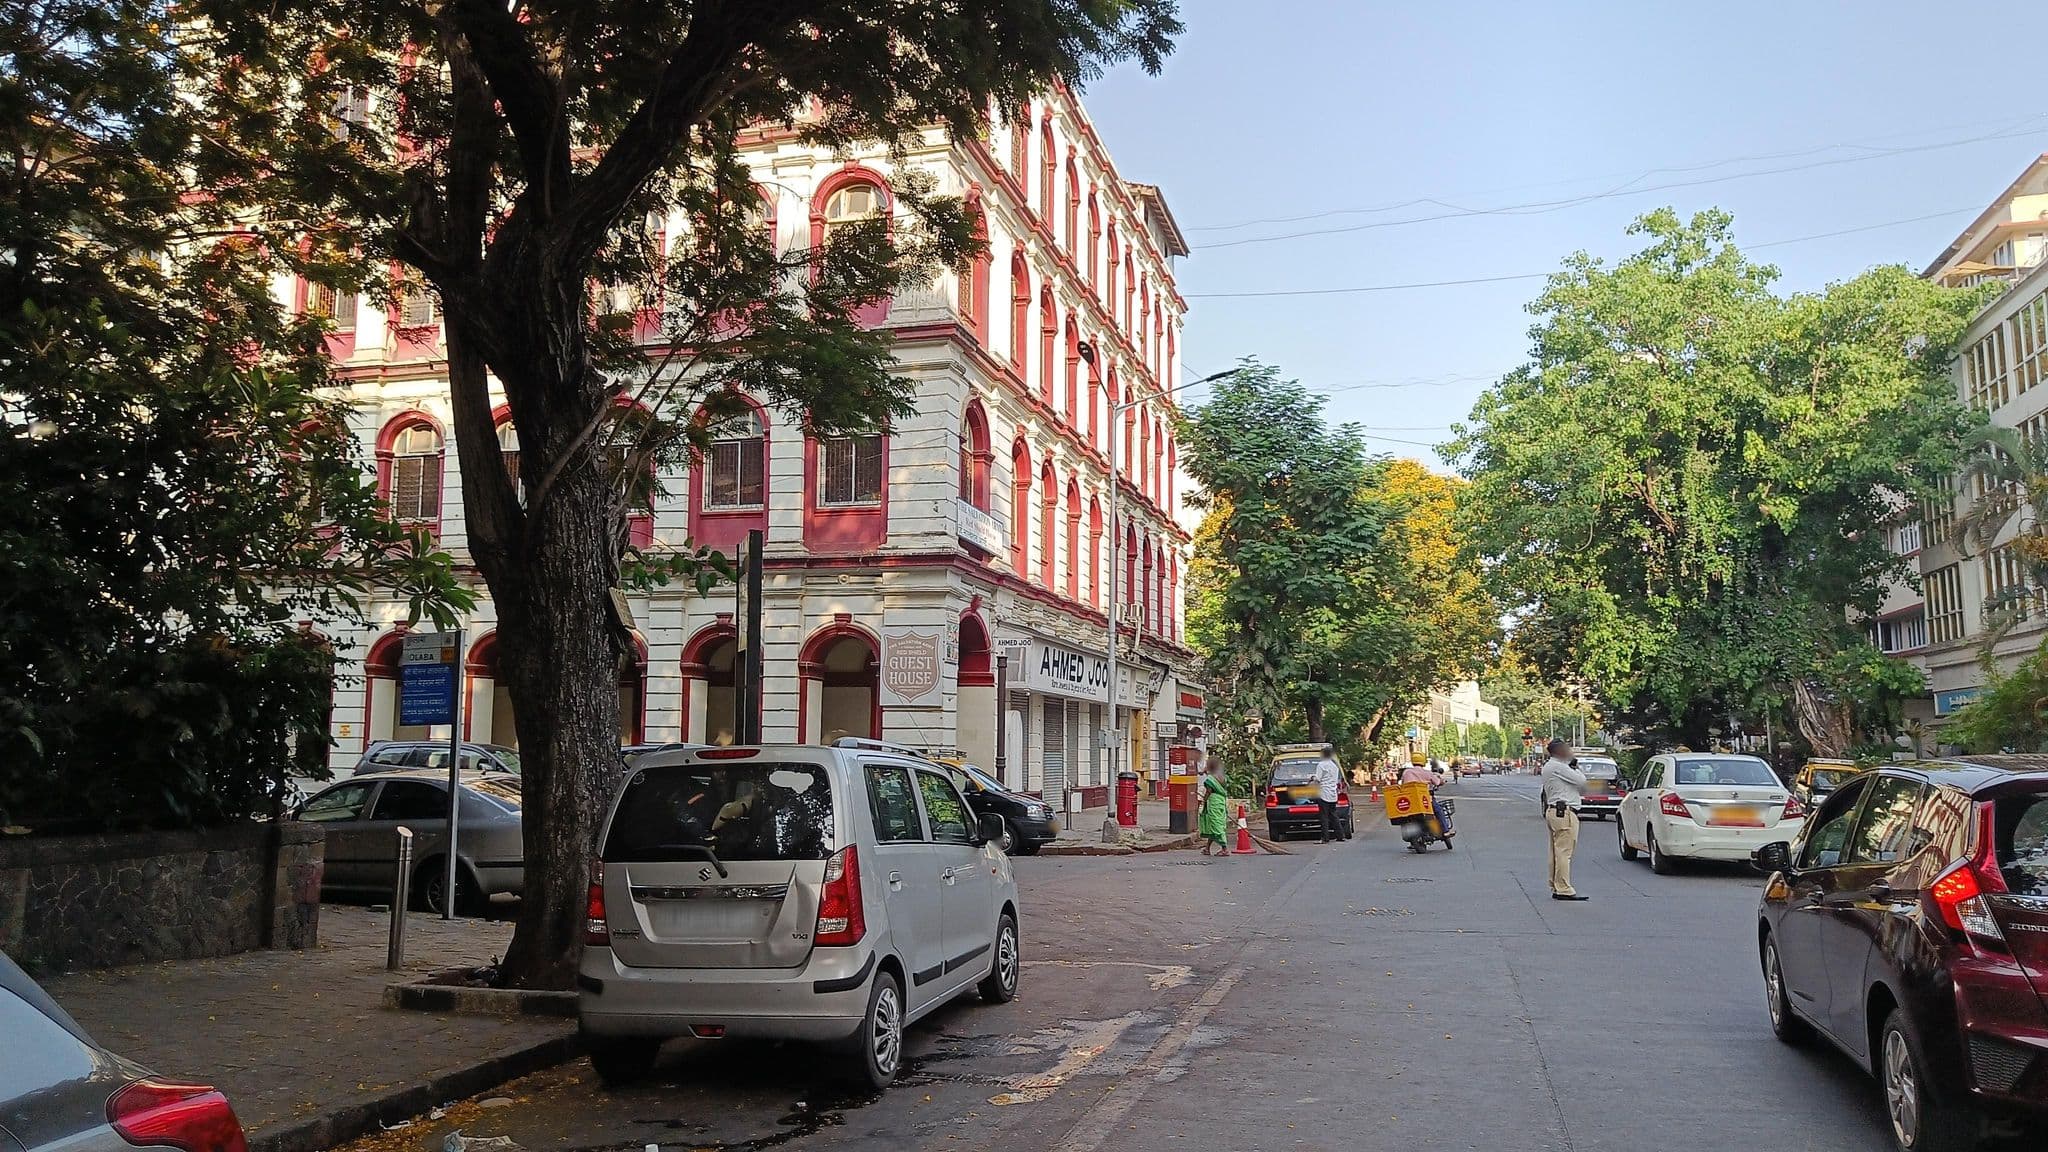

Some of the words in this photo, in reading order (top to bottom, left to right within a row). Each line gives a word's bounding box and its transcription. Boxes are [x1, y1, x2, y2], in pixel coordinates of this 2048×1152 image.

[889, 656, 933, 670] GUEST
[1040, 646, 1085, 683] AHMED
[1088, 659, 1108, 688] JOO
[890, 671, 932, 685] HOUSE
